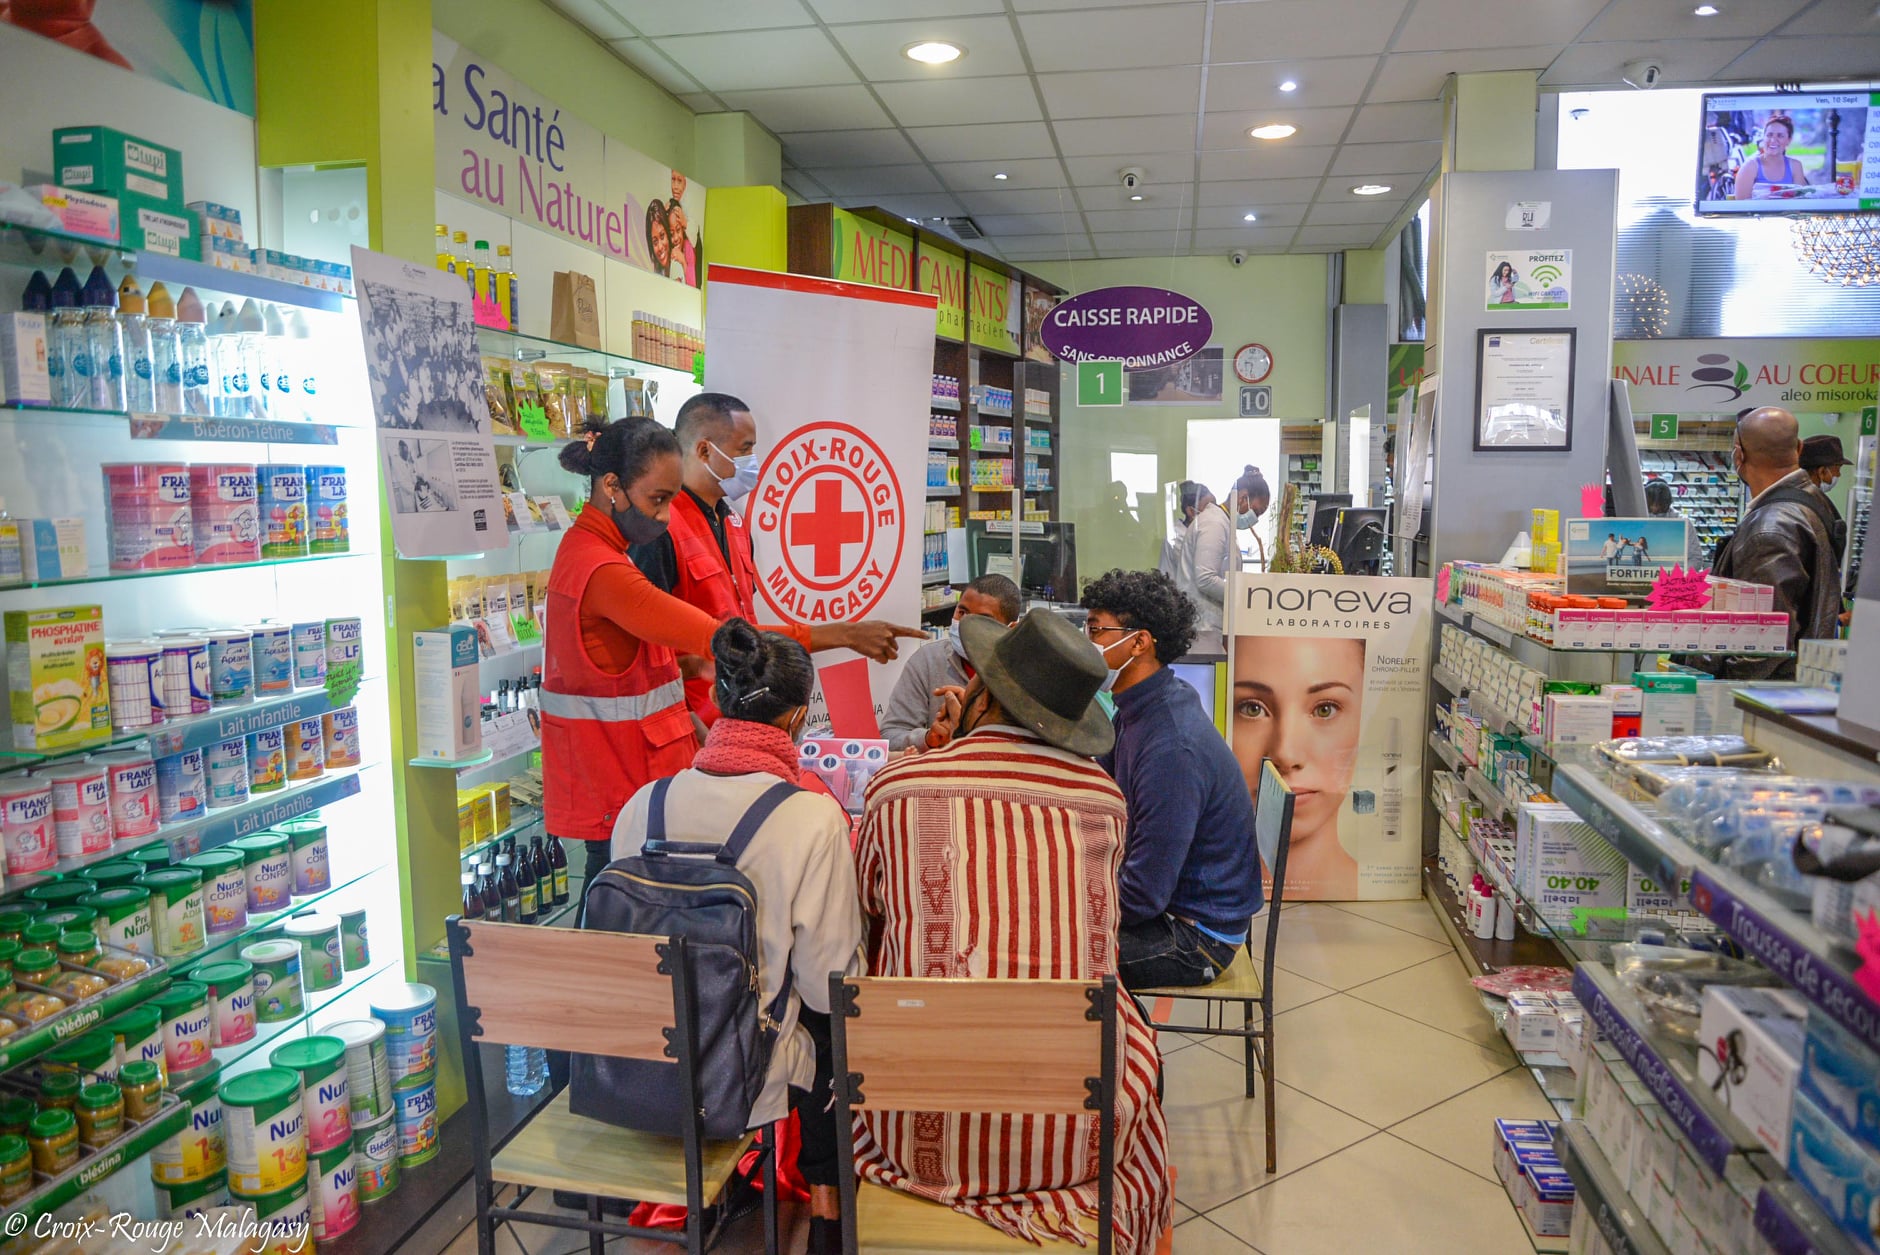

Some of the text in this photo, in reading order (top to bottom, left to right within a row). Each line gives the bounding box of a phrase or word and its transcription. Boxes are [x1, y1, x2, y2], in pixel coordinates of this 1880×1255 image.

[464, 63, 565, 173] Santé
[461, 148, 629, 258] au Naturel
[1529, 255, 1565, 263] PROFITEZ
[1054, 306, 1199, 327] CAISSE RAPIDE
[1060, 345, 1095, 362] SANS
[1096, 372, 1105, 395] 1
[1755, 364, 1791, 386] AU
[1799, 363, 1880, 386] COEUR
[1242, 391, 1269, 411] 10
[1781, 388, 1812, 402] aleo
[194, 421, 294, 441] Bibéron-Tétine
[1659, 420, 1669, 433] 5
[1865, 416, 1873, 429] 6
[758, 437, 895, 533] CROIX-ROUGE
[767, 558, 884, 622] MALAGASY
[1246, 586, 1412, 615] noreva
[31, 620, 101, 639] PHOSPHATINE
[1266, 618, 1391, 630] LABORATOIRES
[341, 630, 359, 640] LAIT
[345, 644, 359, 659] LF
[219, 702, 301, 738] Lait infantile
[131, 776, 152, 789] LAIT
[24, 807, 48, 820] LAIT
[138, 793, 151, 816] 1
[234, 794, 313, 836] Lait infantile
[33, 824, 46, 849] 1
[1547, 876, 1600, 891] 40.40
[1542, 895, 1580, 905] labell
[1636, 898, 1673, 907] labell
[1731, 900, 1792, 972] Trousse
[1793, 952, 1819, 995] de
[55, 1008, 100, 1038] blédina
[1593, 993, 1697, 1133] Dispositif médicaux
[322, 1108, 338, 1135] 2
[79, 1150, 122, 1186] blédina
